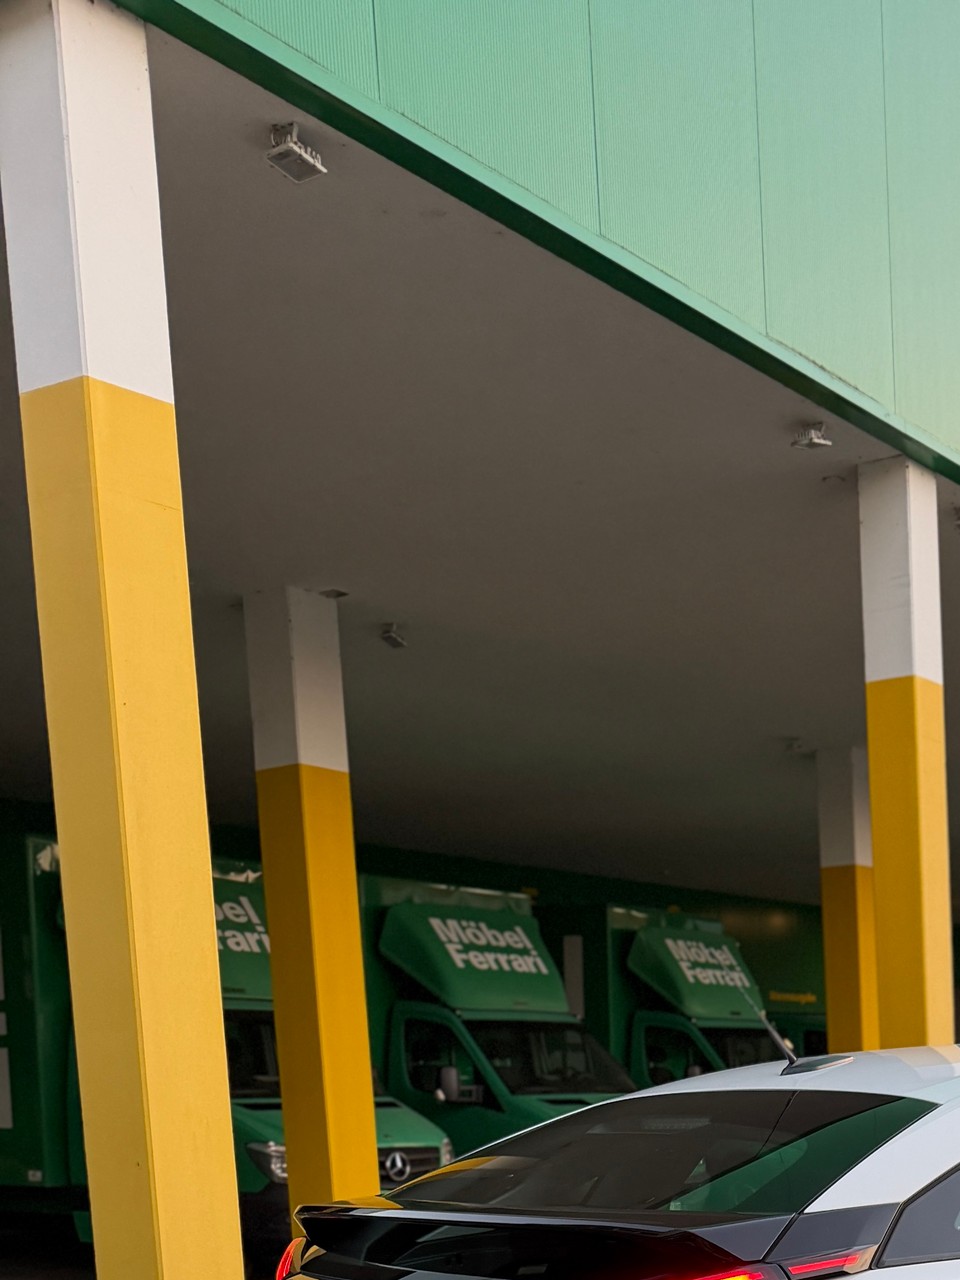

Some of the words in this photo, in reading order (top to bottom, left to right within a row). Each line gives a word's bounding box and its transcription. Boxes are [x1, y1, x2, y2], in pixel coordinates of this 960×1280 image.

[427, 916, 535, 950] Möbel
[444, 943, 549, 976] Ferrari
[663, 937, 737, 966] Möbel
[679, 960, 751, 988] Ferrari
